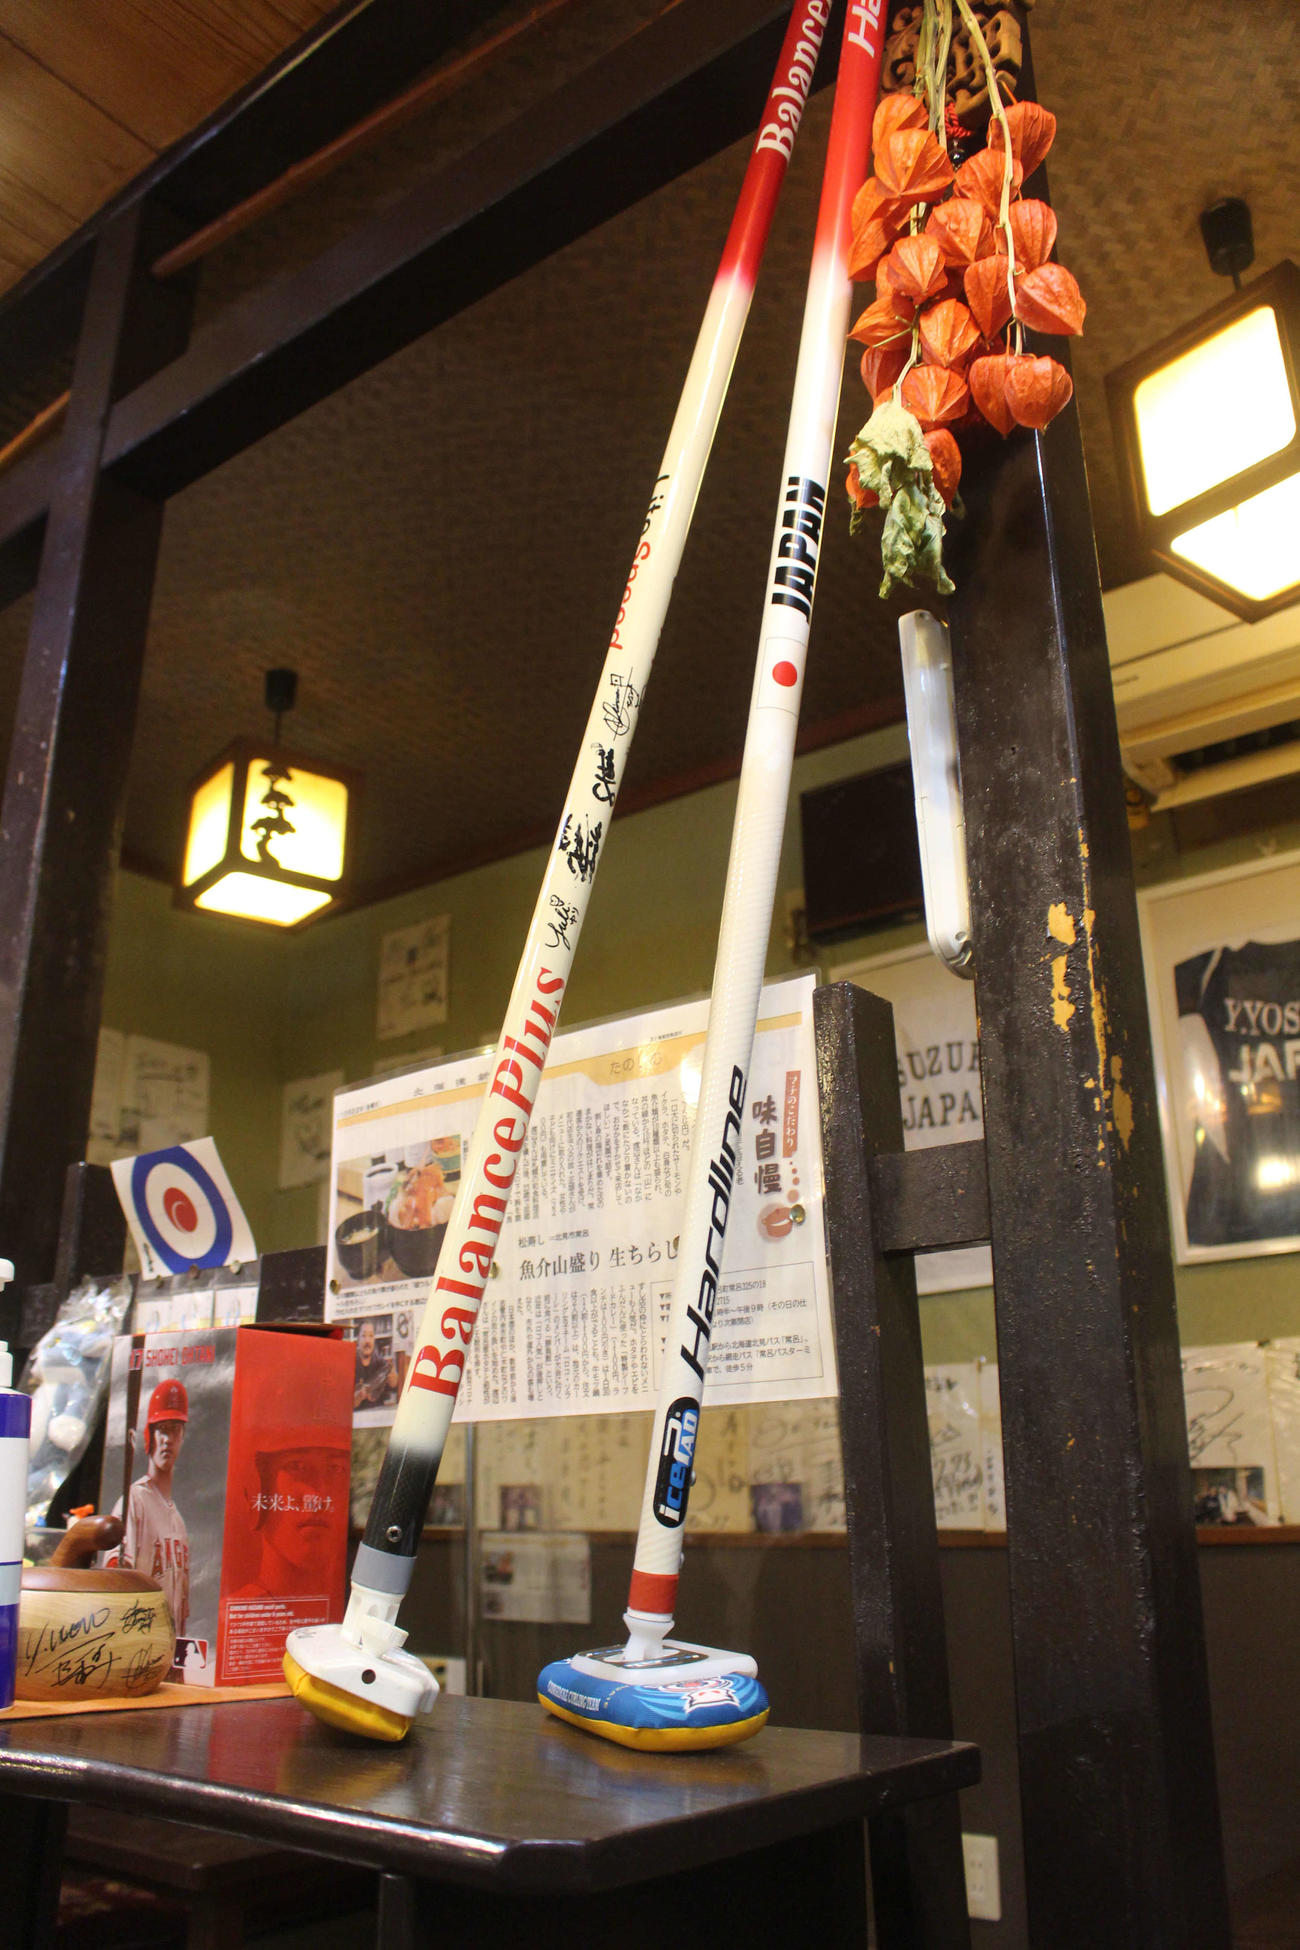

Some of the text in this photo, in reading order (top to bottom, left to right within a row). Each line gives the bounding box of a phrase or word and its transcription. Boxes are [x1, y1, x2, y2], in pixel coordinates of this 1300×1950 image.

[755, 0, 832, 160] Balance
[752, 1094, 782, 1195] 味自慢
[520, 1236, 679, 1281] 魚介山盛り 生ちらし
[680, 1064, 747, 1383] Hardline
